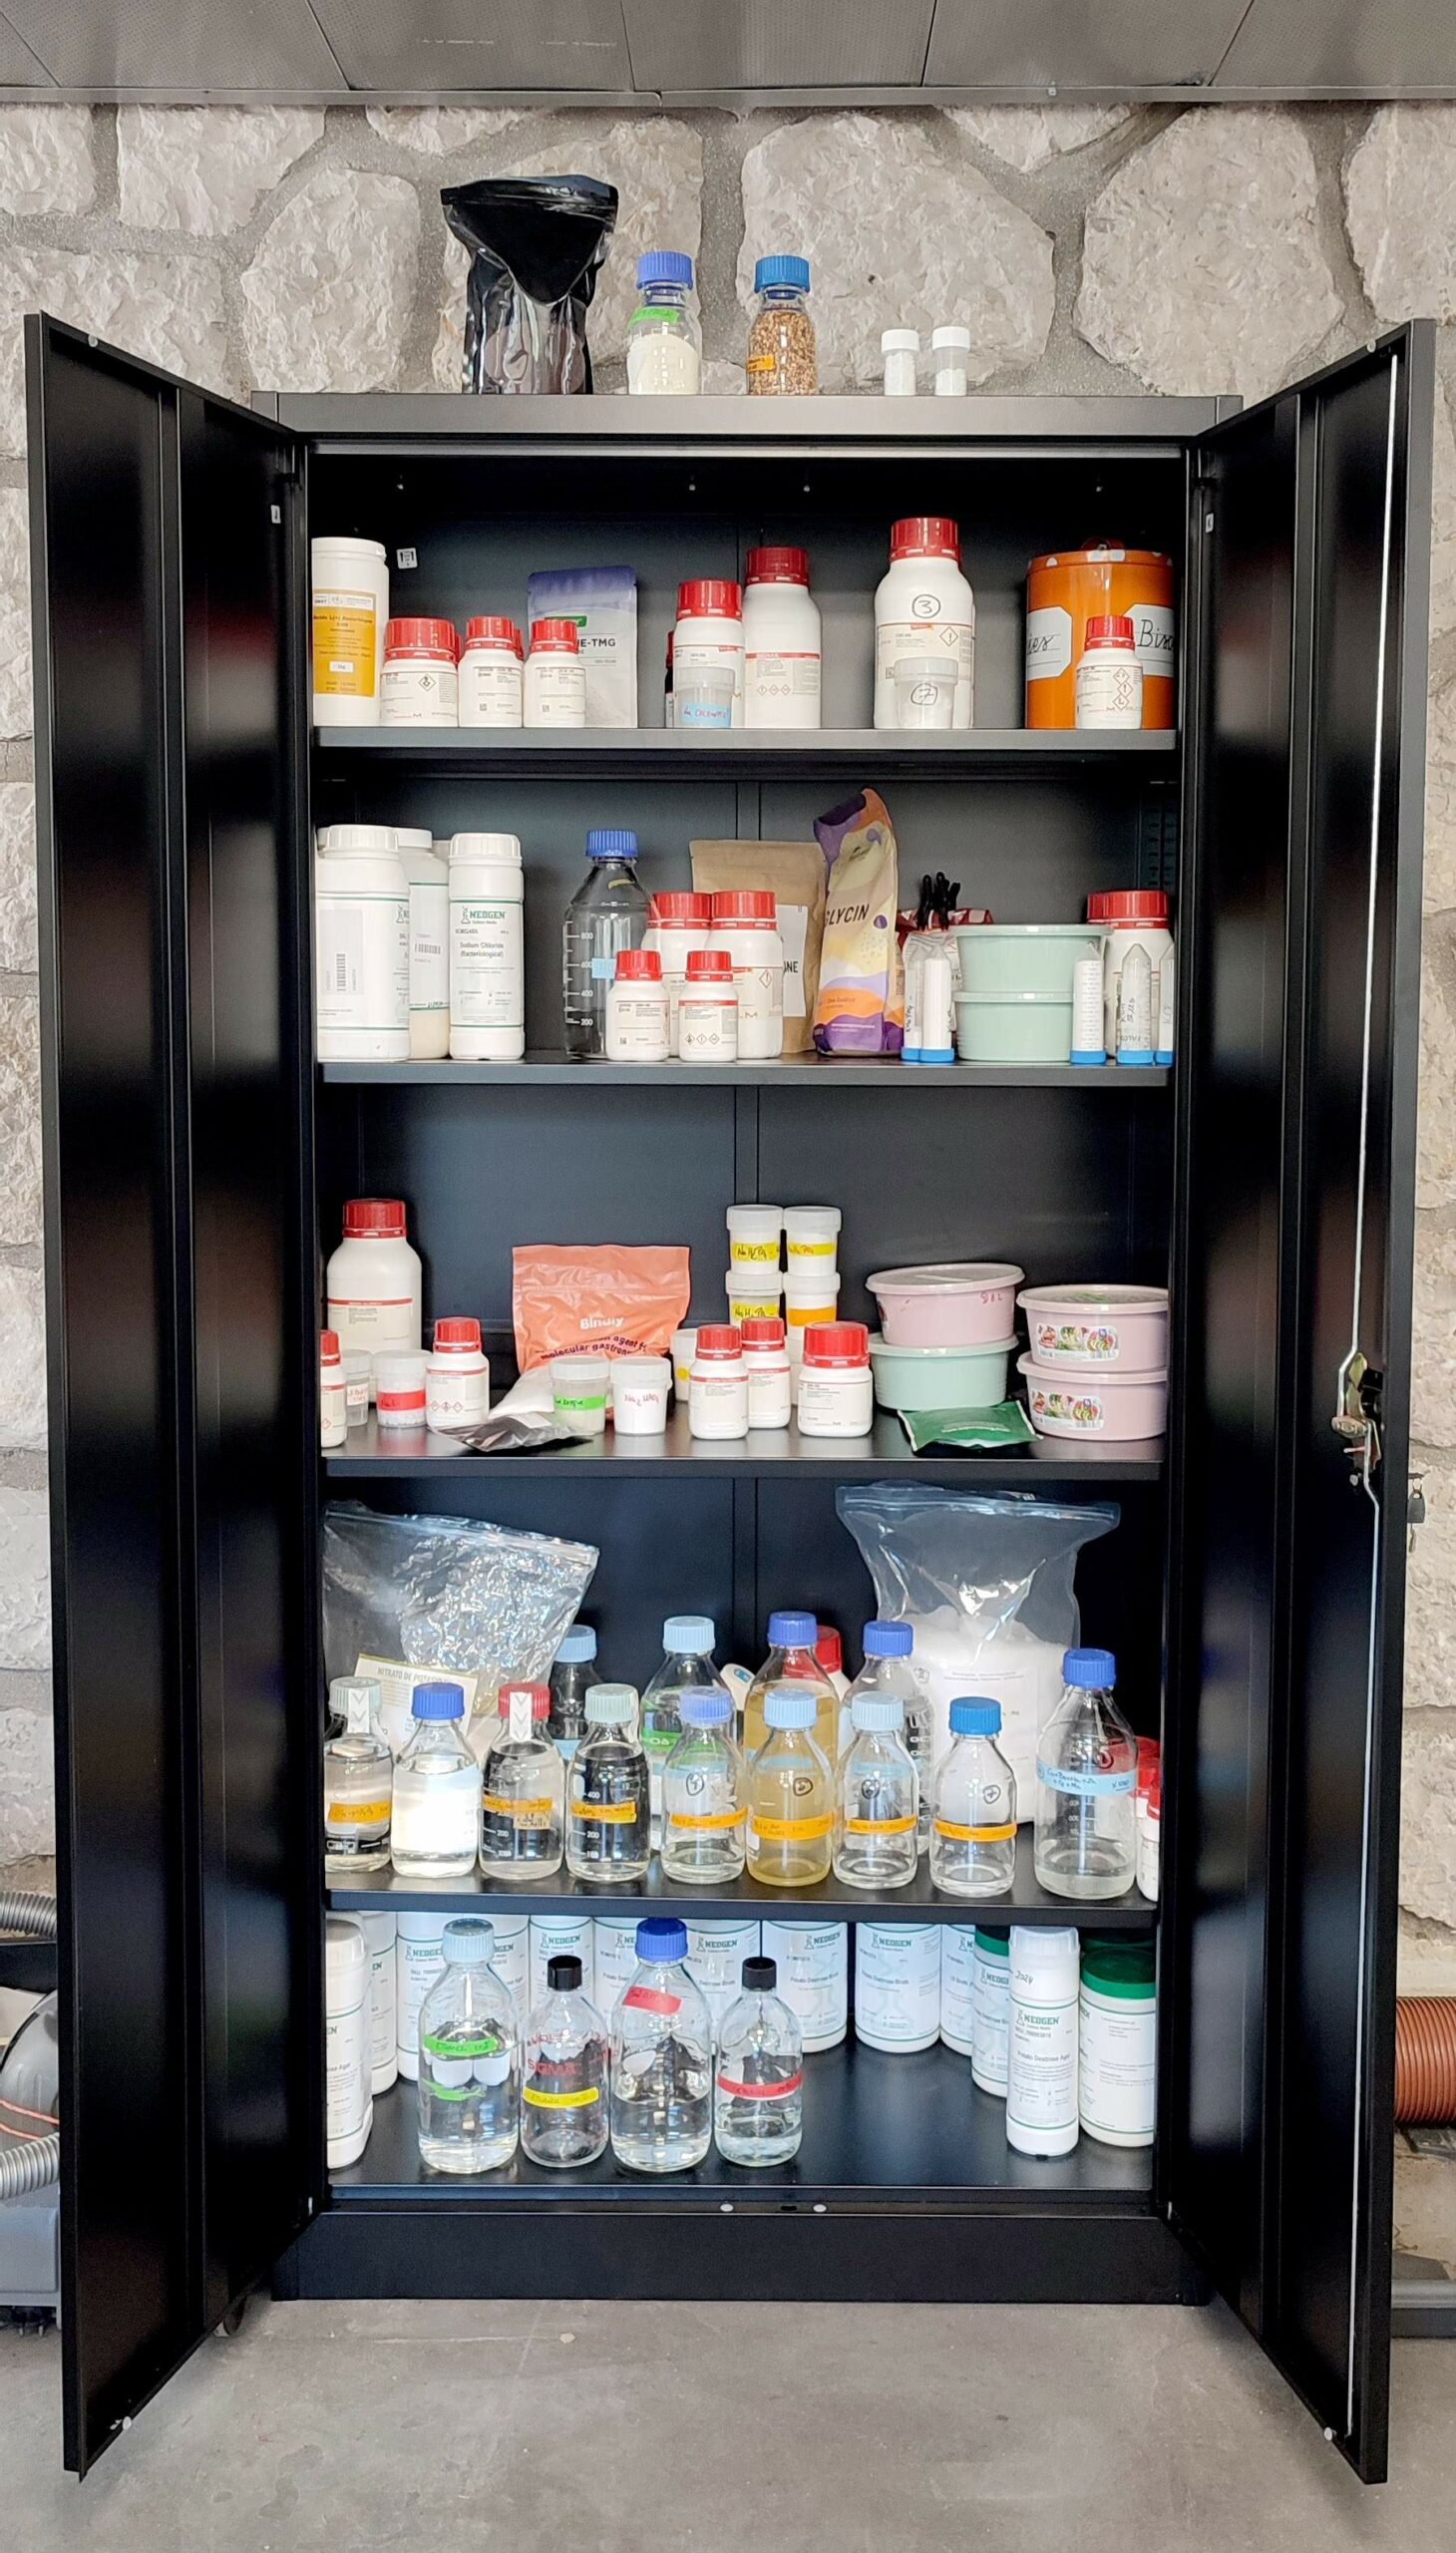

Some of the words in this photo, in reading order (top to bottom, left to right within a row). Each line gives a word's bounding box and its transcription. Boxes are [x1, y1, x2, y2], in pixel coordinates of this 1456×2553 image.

[613, 1335, 638, 1347] agent
[540, 1343, 589, 1361] molecular
[591, 1341, 633, 1355] gastron
[412, 1948, 442, 1958] NEOGE
